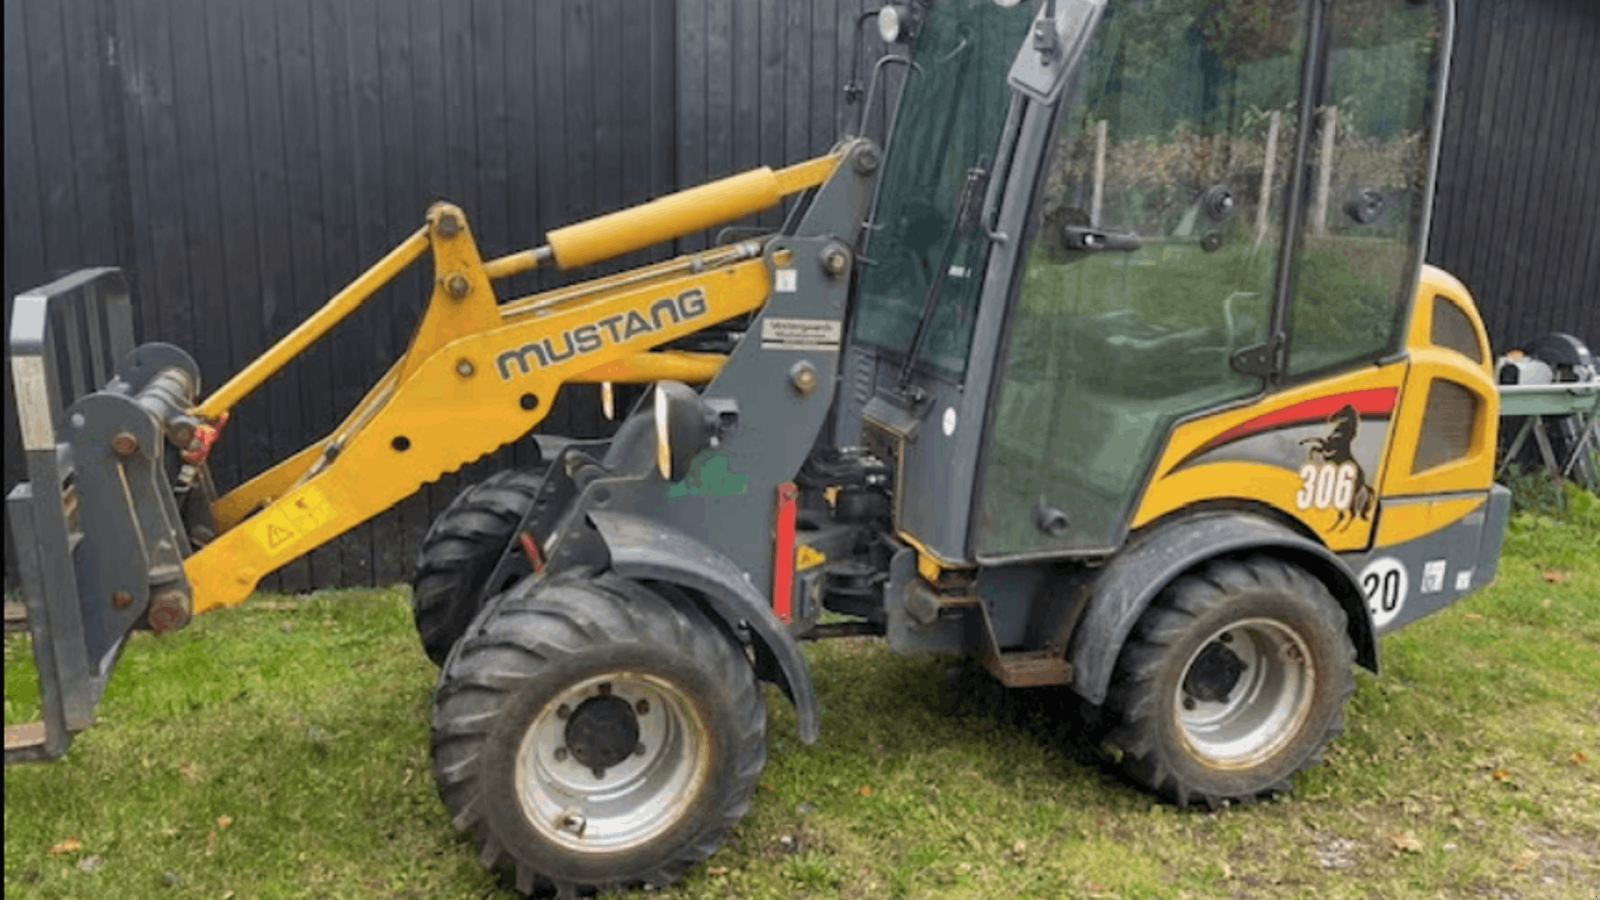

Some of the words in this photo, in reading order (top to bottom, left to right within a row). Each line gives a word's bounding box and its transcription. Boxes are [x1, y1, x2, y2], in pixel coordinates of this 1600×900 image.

[496, 288, 707, 380] MUSTANG
[1297, 464, 1354, 509] 306
[1364, 568, 1400, 613] 20
